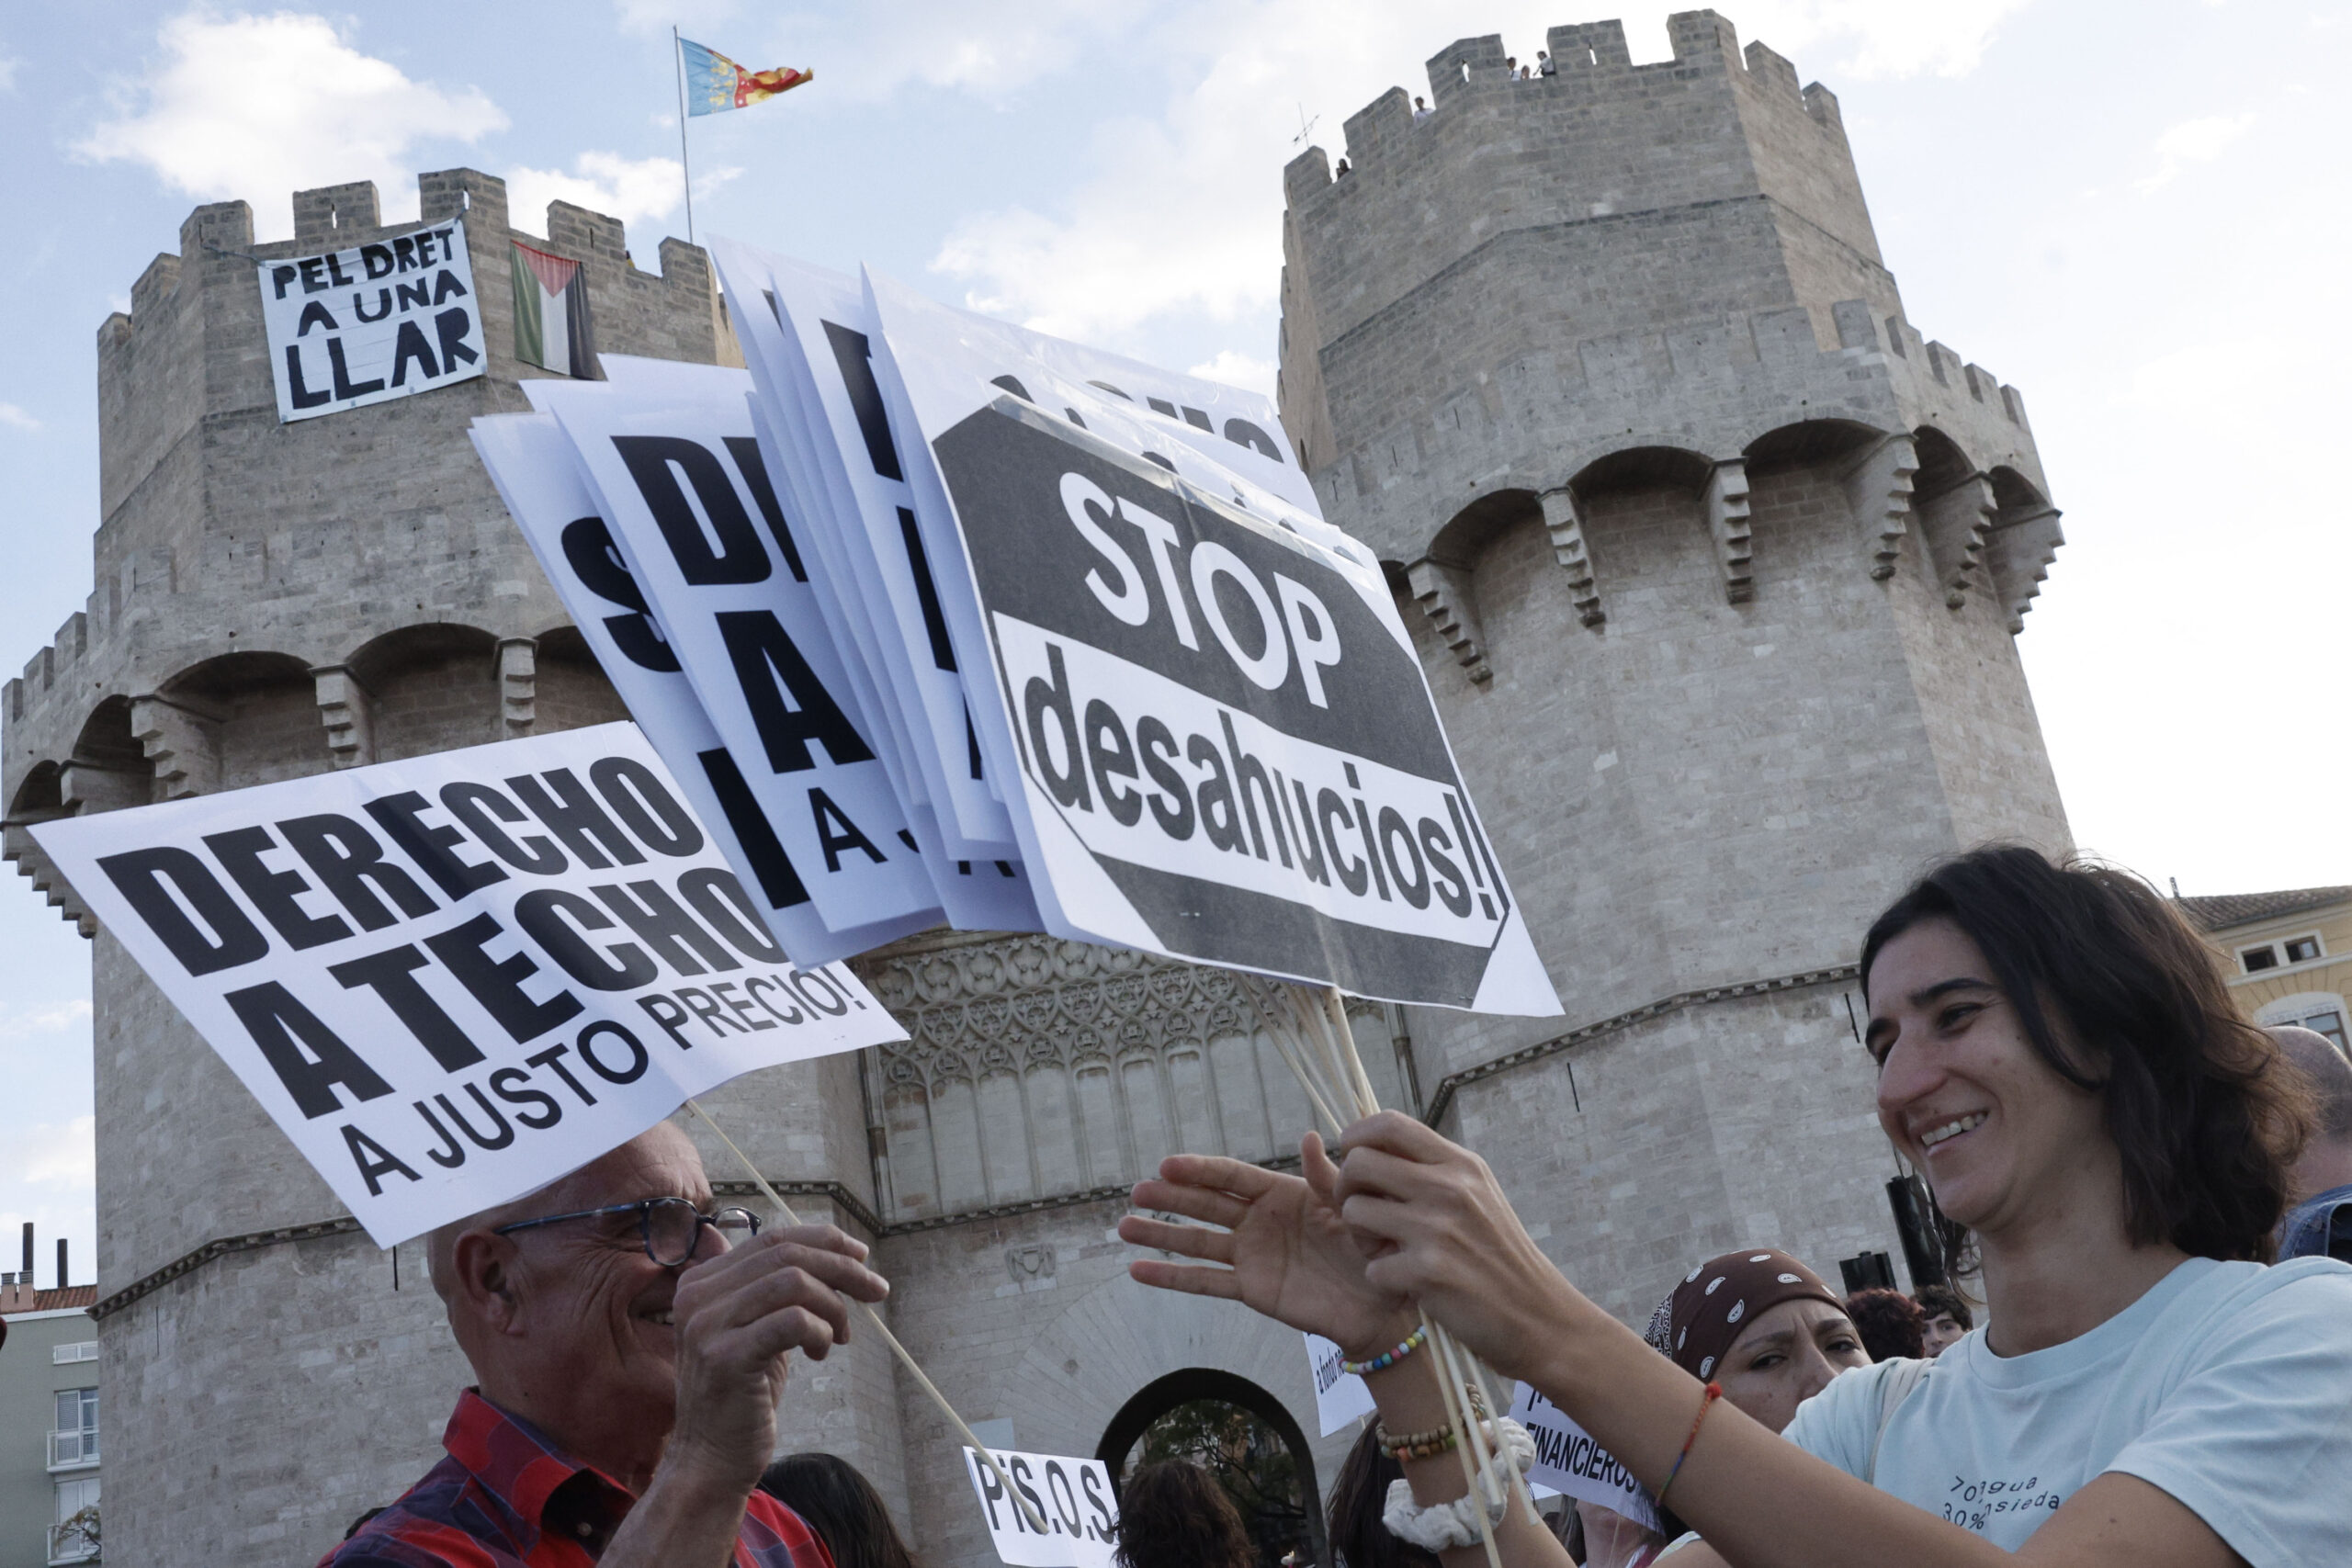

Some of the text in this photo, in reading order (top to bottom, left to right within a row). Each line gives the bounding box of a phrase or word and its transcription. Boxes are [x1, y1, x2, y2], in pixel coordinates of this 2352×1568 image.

[272, 227, 454, 300] PEL DRET
[297, 269, 468, 338] A UNA
[286, 307, 480, 410] LLAR
[1059, 471, 1341, 709] STOP
[1023, 640, 1499, 921] desahucios!
[96, 756, 706, 978] DERECHO
[340, 964, 868, 1197] A JUSTO PRECIO!
[1525, 1422, 1637, 1494] INANCIERO
